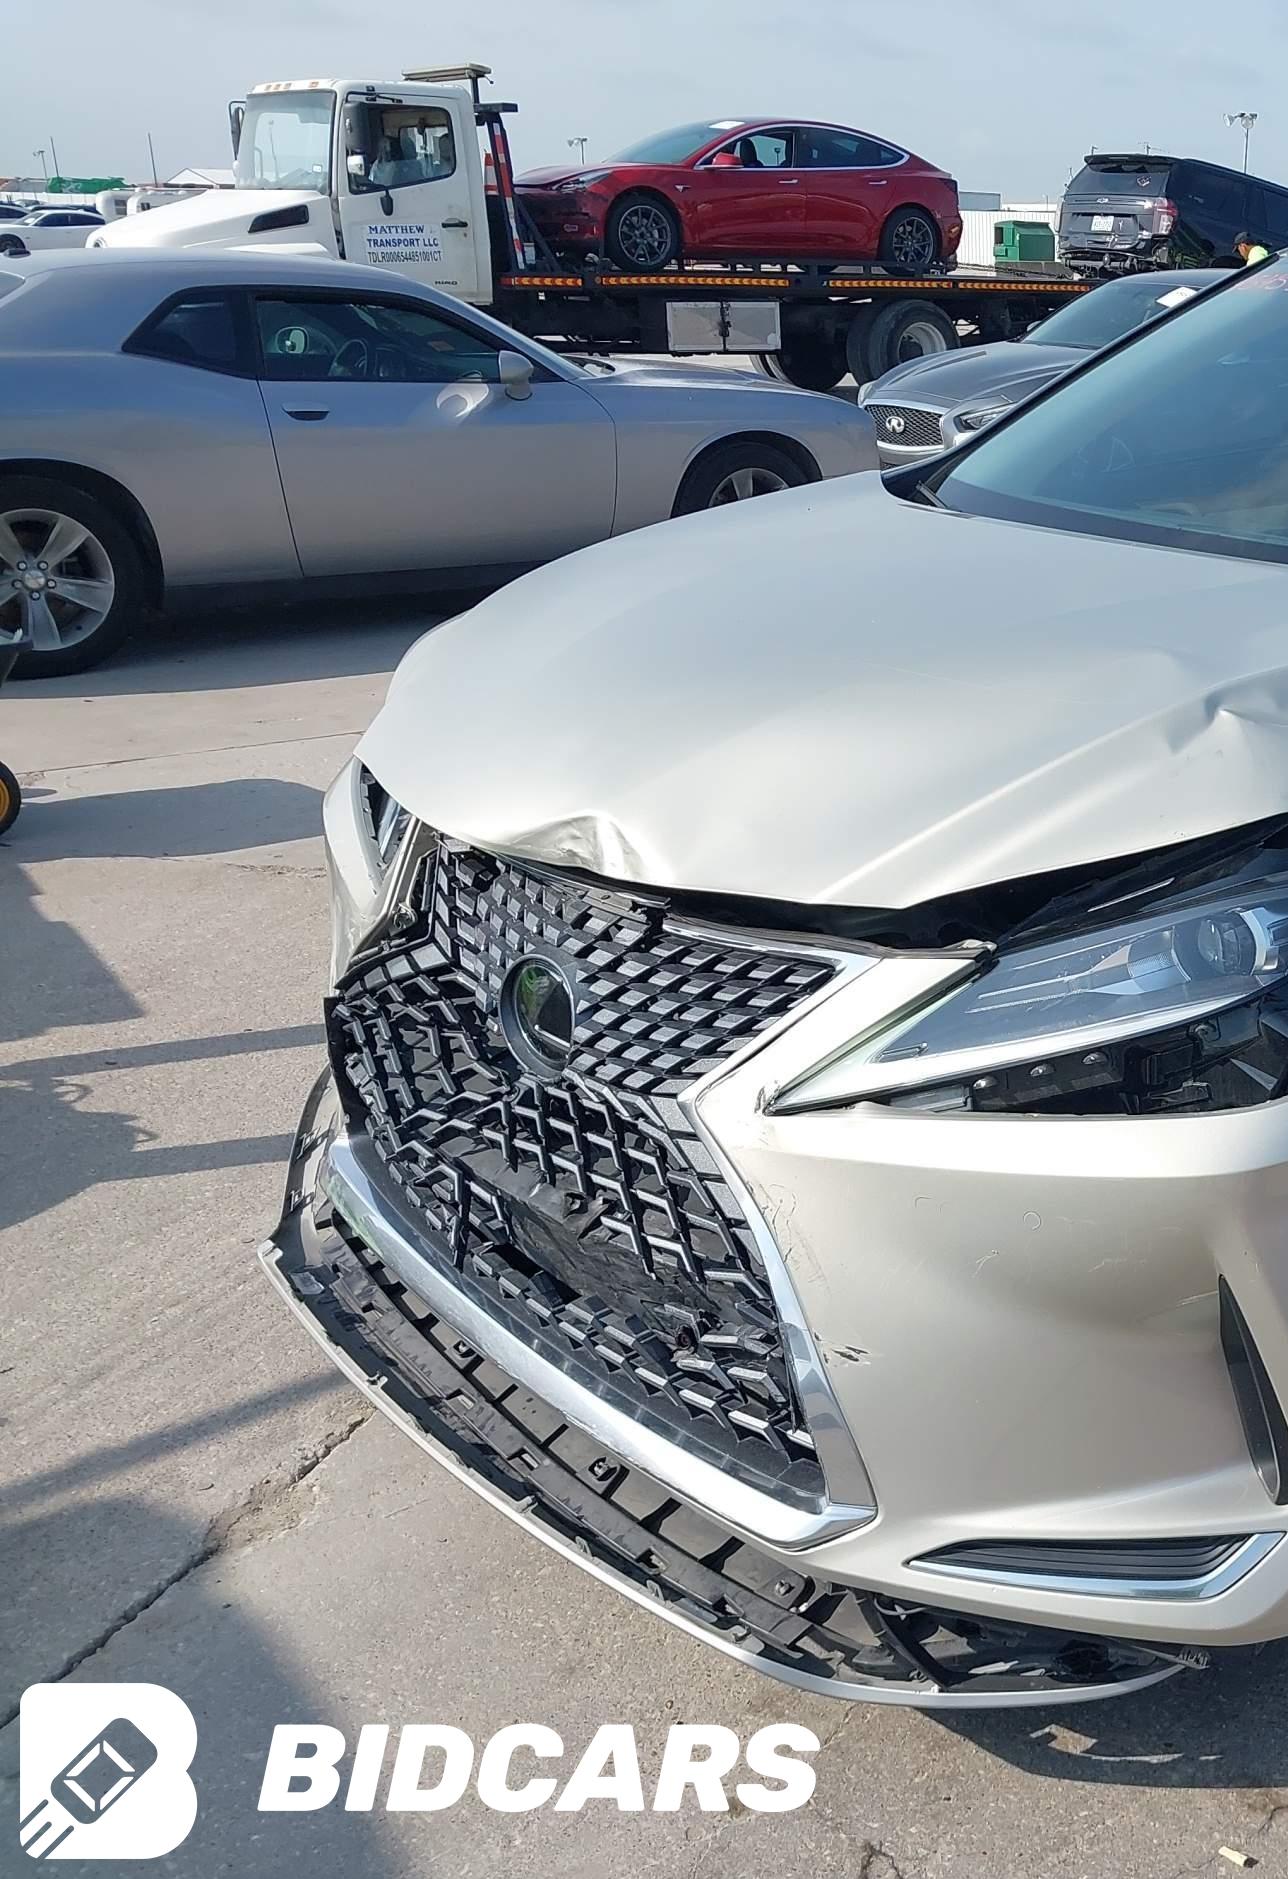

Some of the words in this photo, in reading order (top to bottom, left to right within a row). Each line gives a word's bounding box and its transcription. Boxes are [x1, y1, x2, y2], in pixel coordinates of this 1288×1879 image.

[368, 225, 425, 234] MATTHEW
[367, 238, 421, 248] TRANSPORT
[423, 238, 439, 247] LLC
